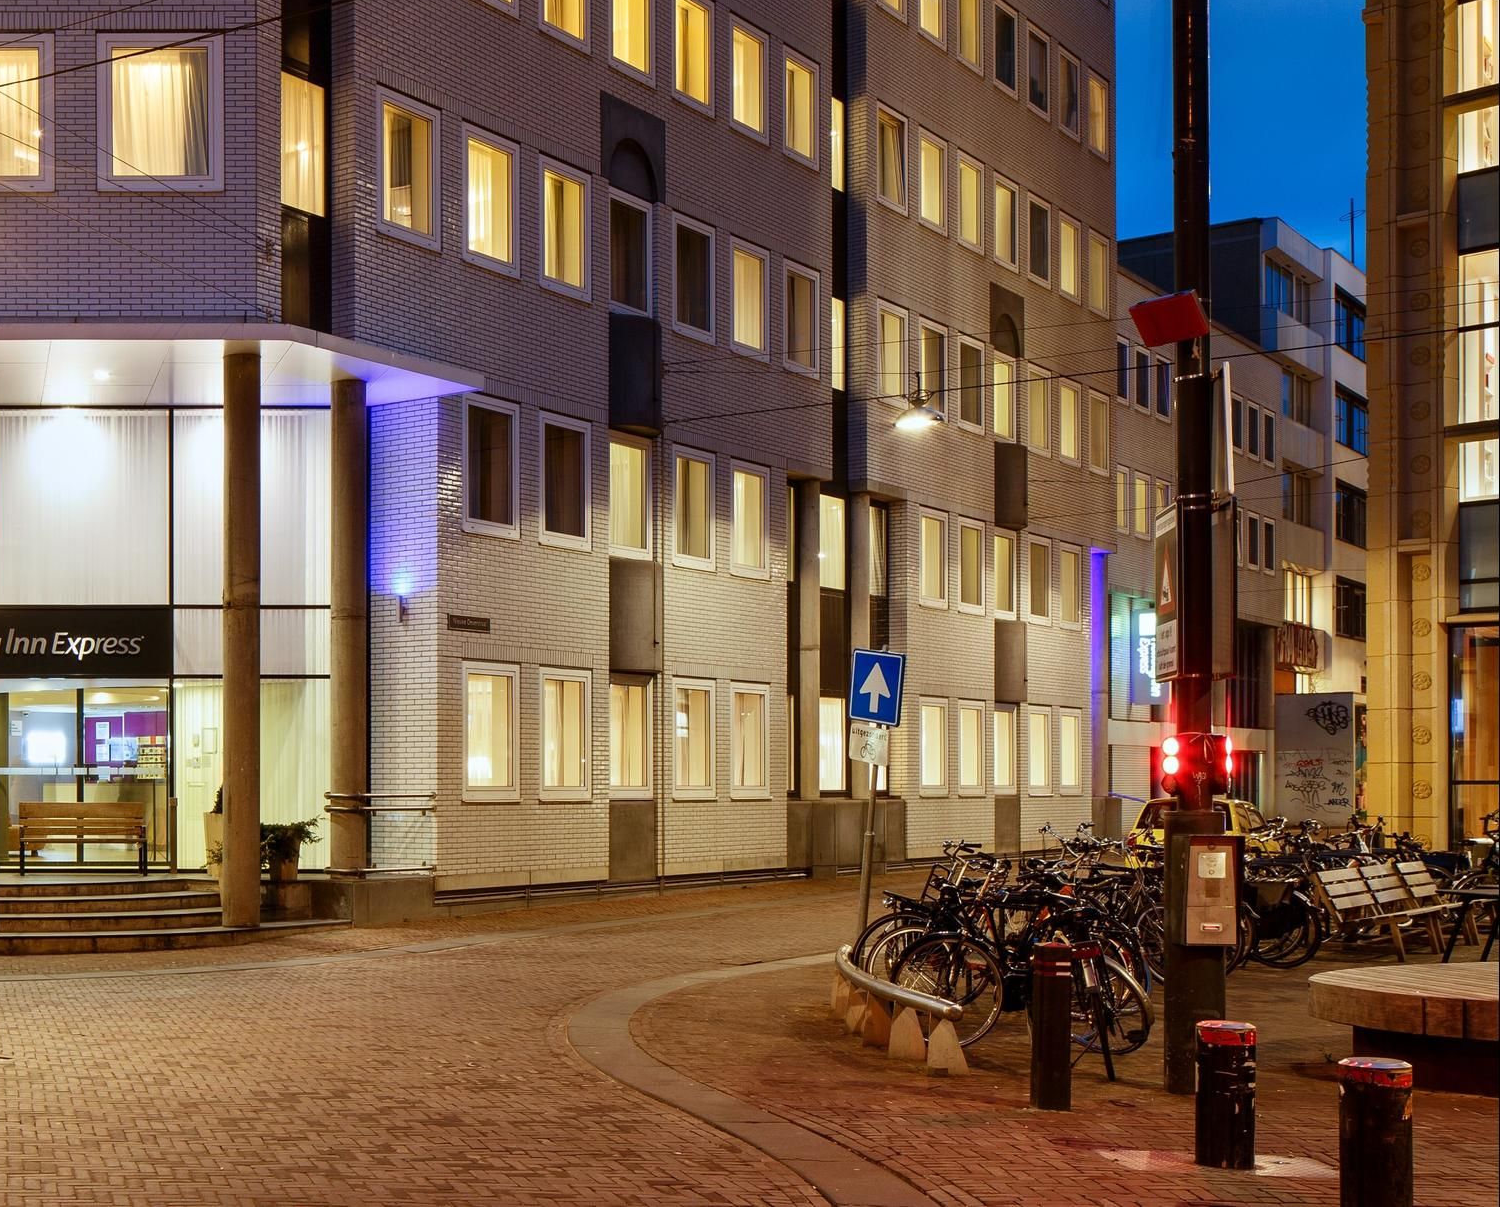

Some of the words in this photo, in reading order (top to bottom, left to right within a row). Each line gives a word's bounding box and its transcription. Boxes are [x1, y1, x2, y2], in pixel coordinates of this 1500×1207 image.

[4, 627, 47, 655] Inn
[51, 631, 142, 661] Express
[851, 726, 887, 741] uitgezerd
